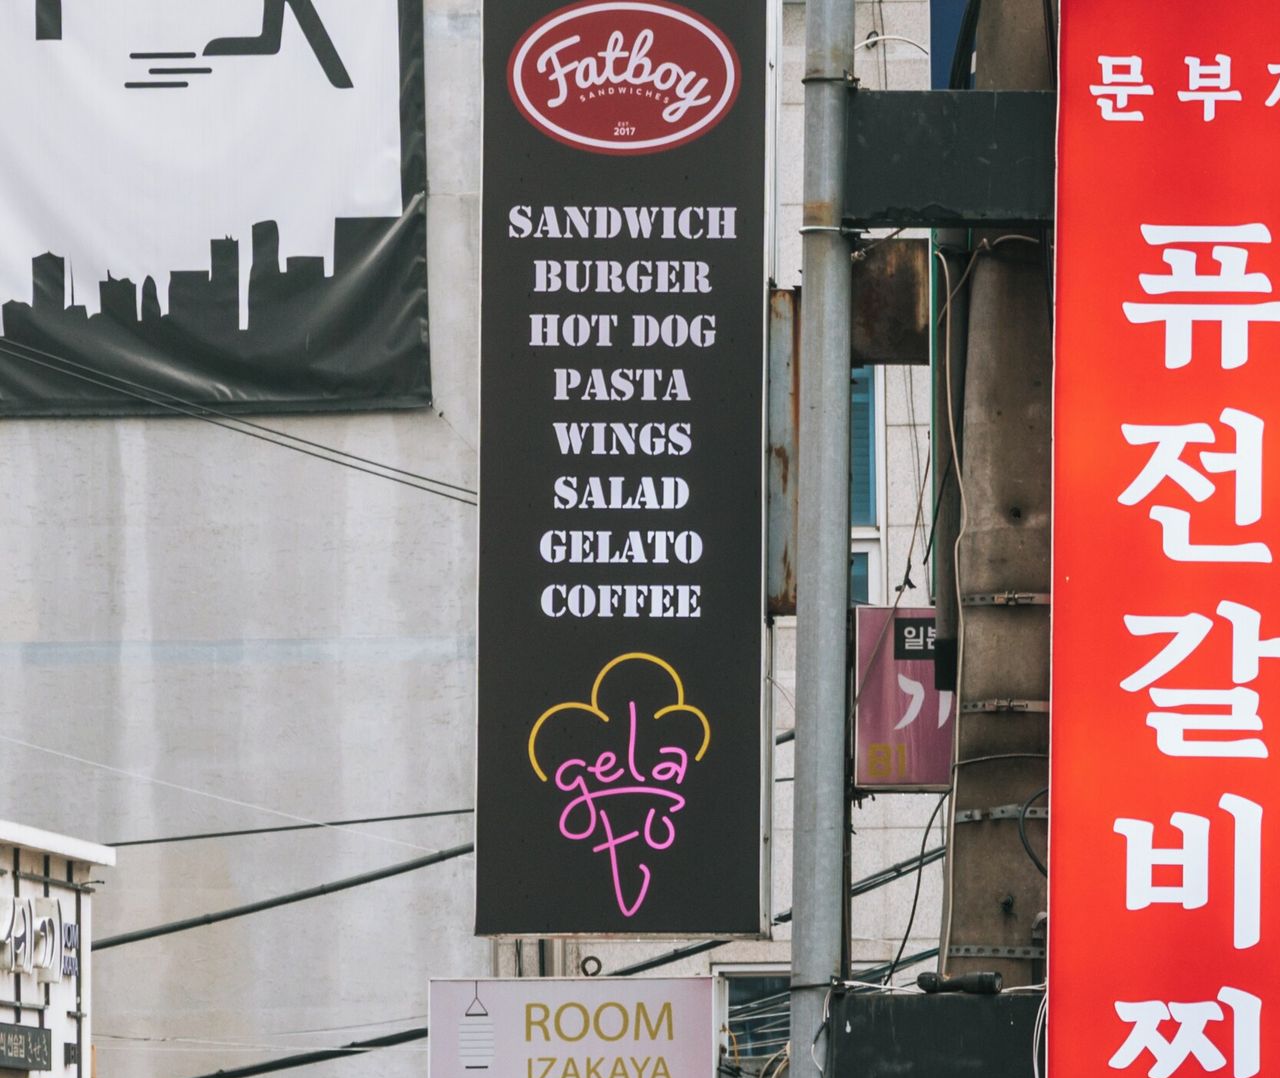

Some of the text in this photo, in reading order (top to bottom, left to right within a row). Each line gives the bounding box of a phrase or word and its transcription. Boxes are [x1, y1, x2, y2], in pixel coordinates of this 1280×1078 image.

[537, 28, 711, 123] Fatboy
[579, 87, 670, 104] SANDWICHES
[613, 127, 636, 136] 2017
[508, 206, 738, 241] SANDWICH
[533, 261, 712, 294] BURGER
[529, 314, 717, 348] HOT DOG
[554, 369, 691, 401] PASTA
[553, 423, 692, 456] WINGS
[554, 477, 690, 510] SALAD
[539, 531, 703, 564] GELATO
[540, 585, 702, 618] COFFEE
[524, 1001, 674, 1042] ROOM
